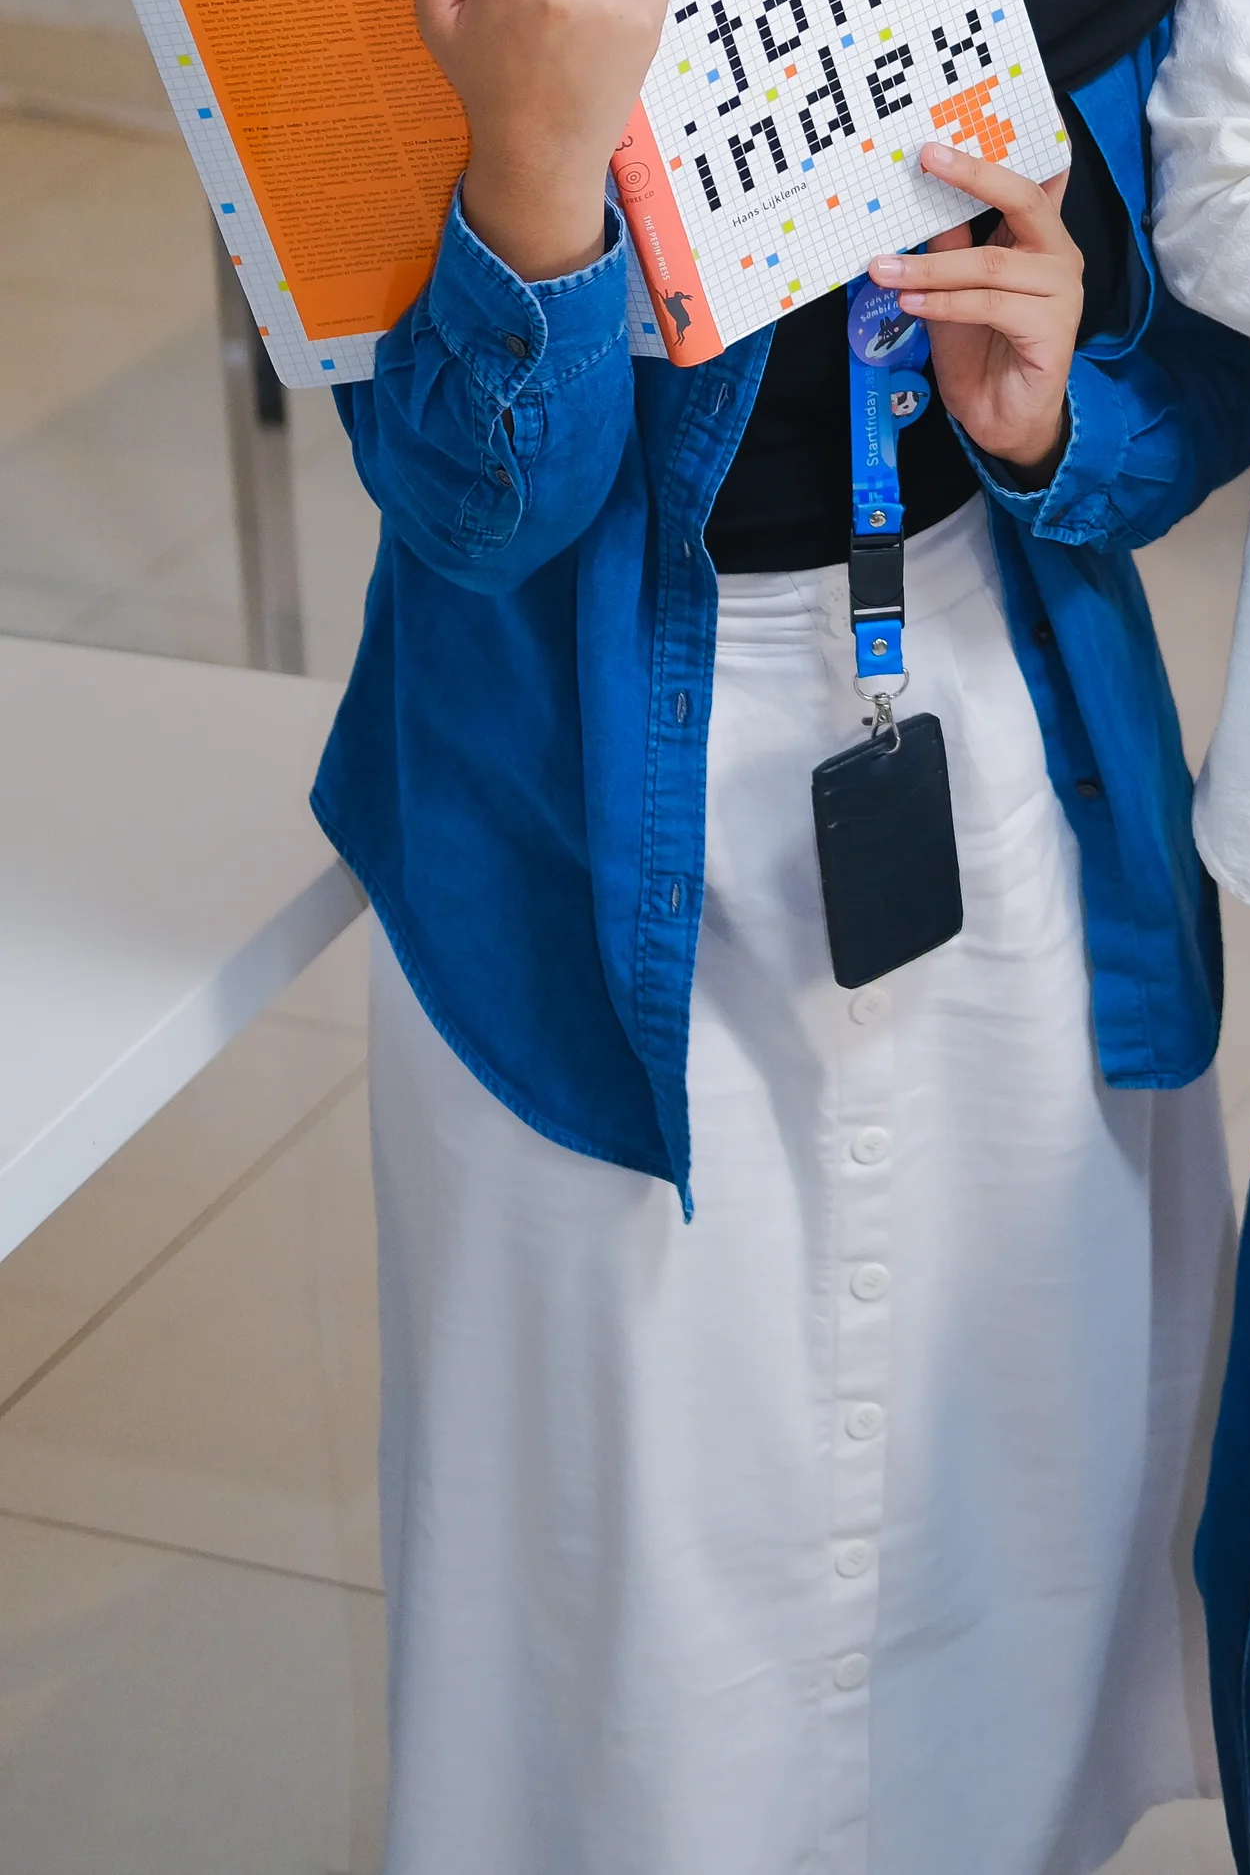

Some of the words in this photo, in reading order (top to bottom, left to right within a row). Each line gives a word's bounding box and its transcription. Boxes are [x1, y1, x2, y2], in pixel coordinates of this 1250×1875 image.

[684, 9, 993, 212] index
[625, 195, 643, 204] FREE
[644, 190, 655, 200] CD
[732, 207, 760, 227] Hans
[762, 182, 807, 210] Lijklema
[643, 215, 655, 231] THE
[649, 232, 662, 255] PEPIN
[657, 255, 671, 281] PRESS
